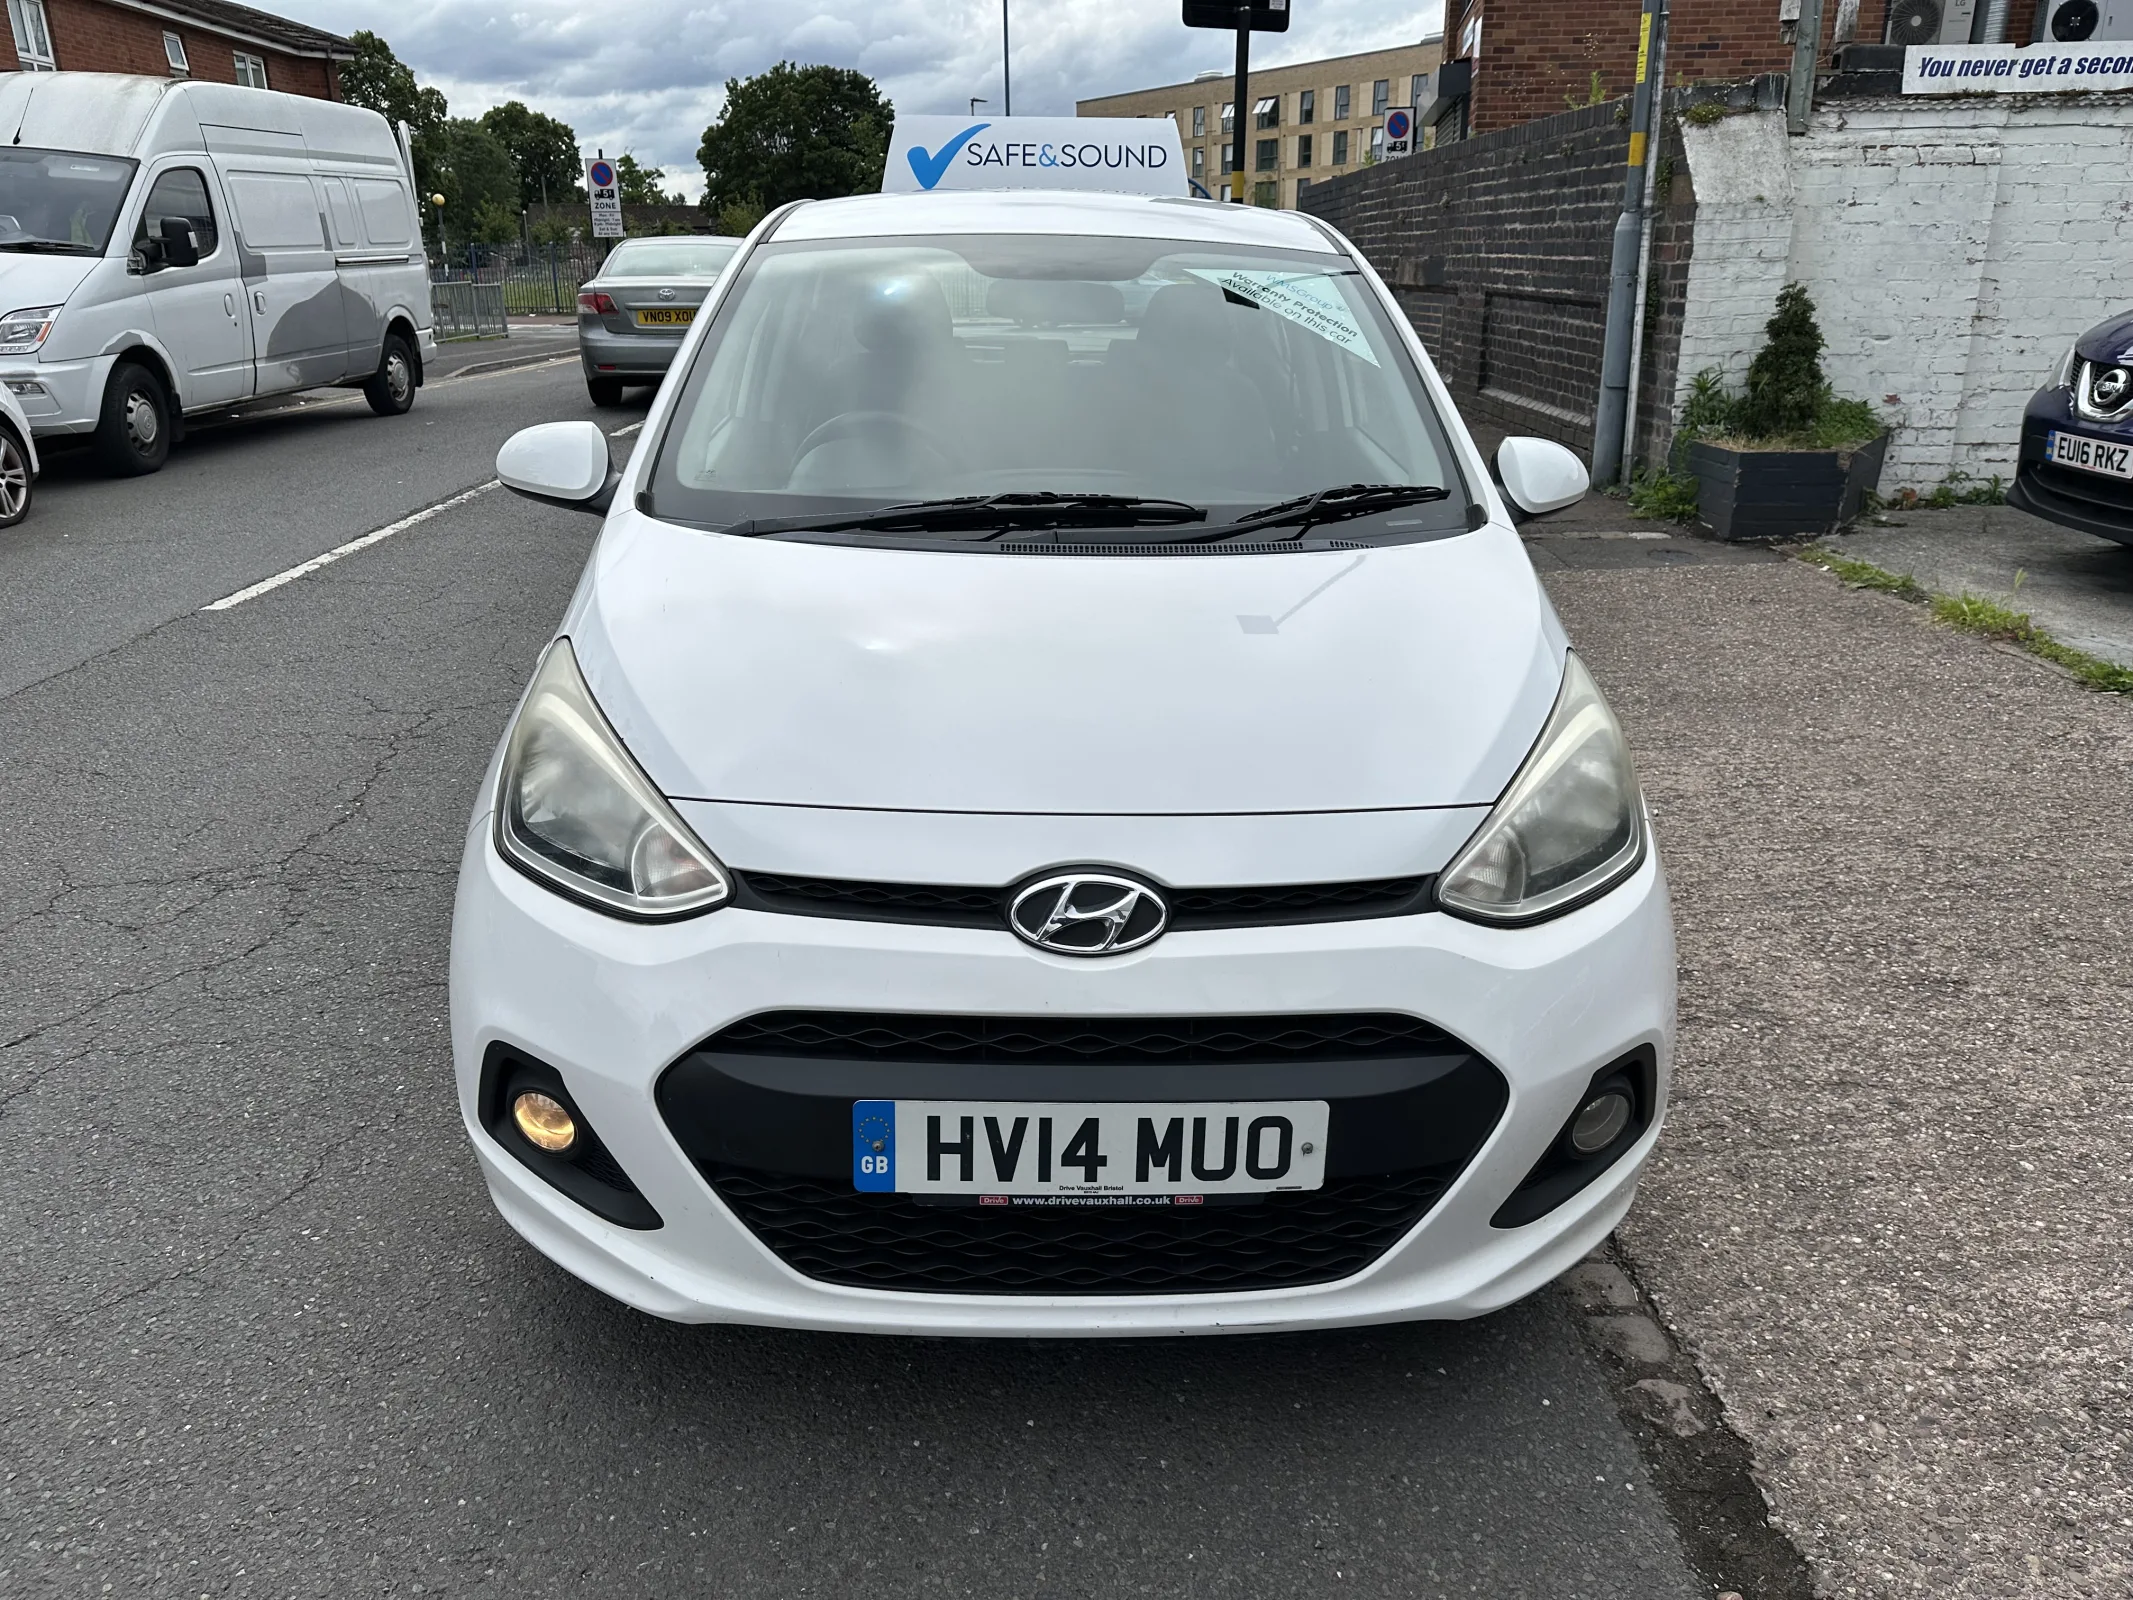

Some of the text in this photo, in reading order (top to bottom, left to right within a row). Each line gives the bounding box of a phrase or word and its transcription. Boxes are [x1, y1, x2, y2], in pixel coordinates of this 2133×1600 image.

[1919, 57, 1956, 77] You
[1957, 59, 2018, 77] never
[2018, 56, 2057, 78] get
[2057, 57, 2072, 75] a
[966, 143, 1167, 168] SAFE&SOUND
[594, 202, 617, 210] ZONE
[1266, 274, 1333, 311] WMSGroup
[1222, 278, 1353, 345] Available on this car
[1232, 272, 1358, 337] Warranty Protection
[642, 311, 671, 323] VN09
[2057, 436, 2129, 473] EU16 RKZ
[926, 1115, 1293, 1183] HV14 MUO
[861, 1156, 889, 1174] GB
[1012, 1195, 1171, 1206] www.drivevauxhall.co.uk
[1179, 1195, 1199, 1204] Drive
